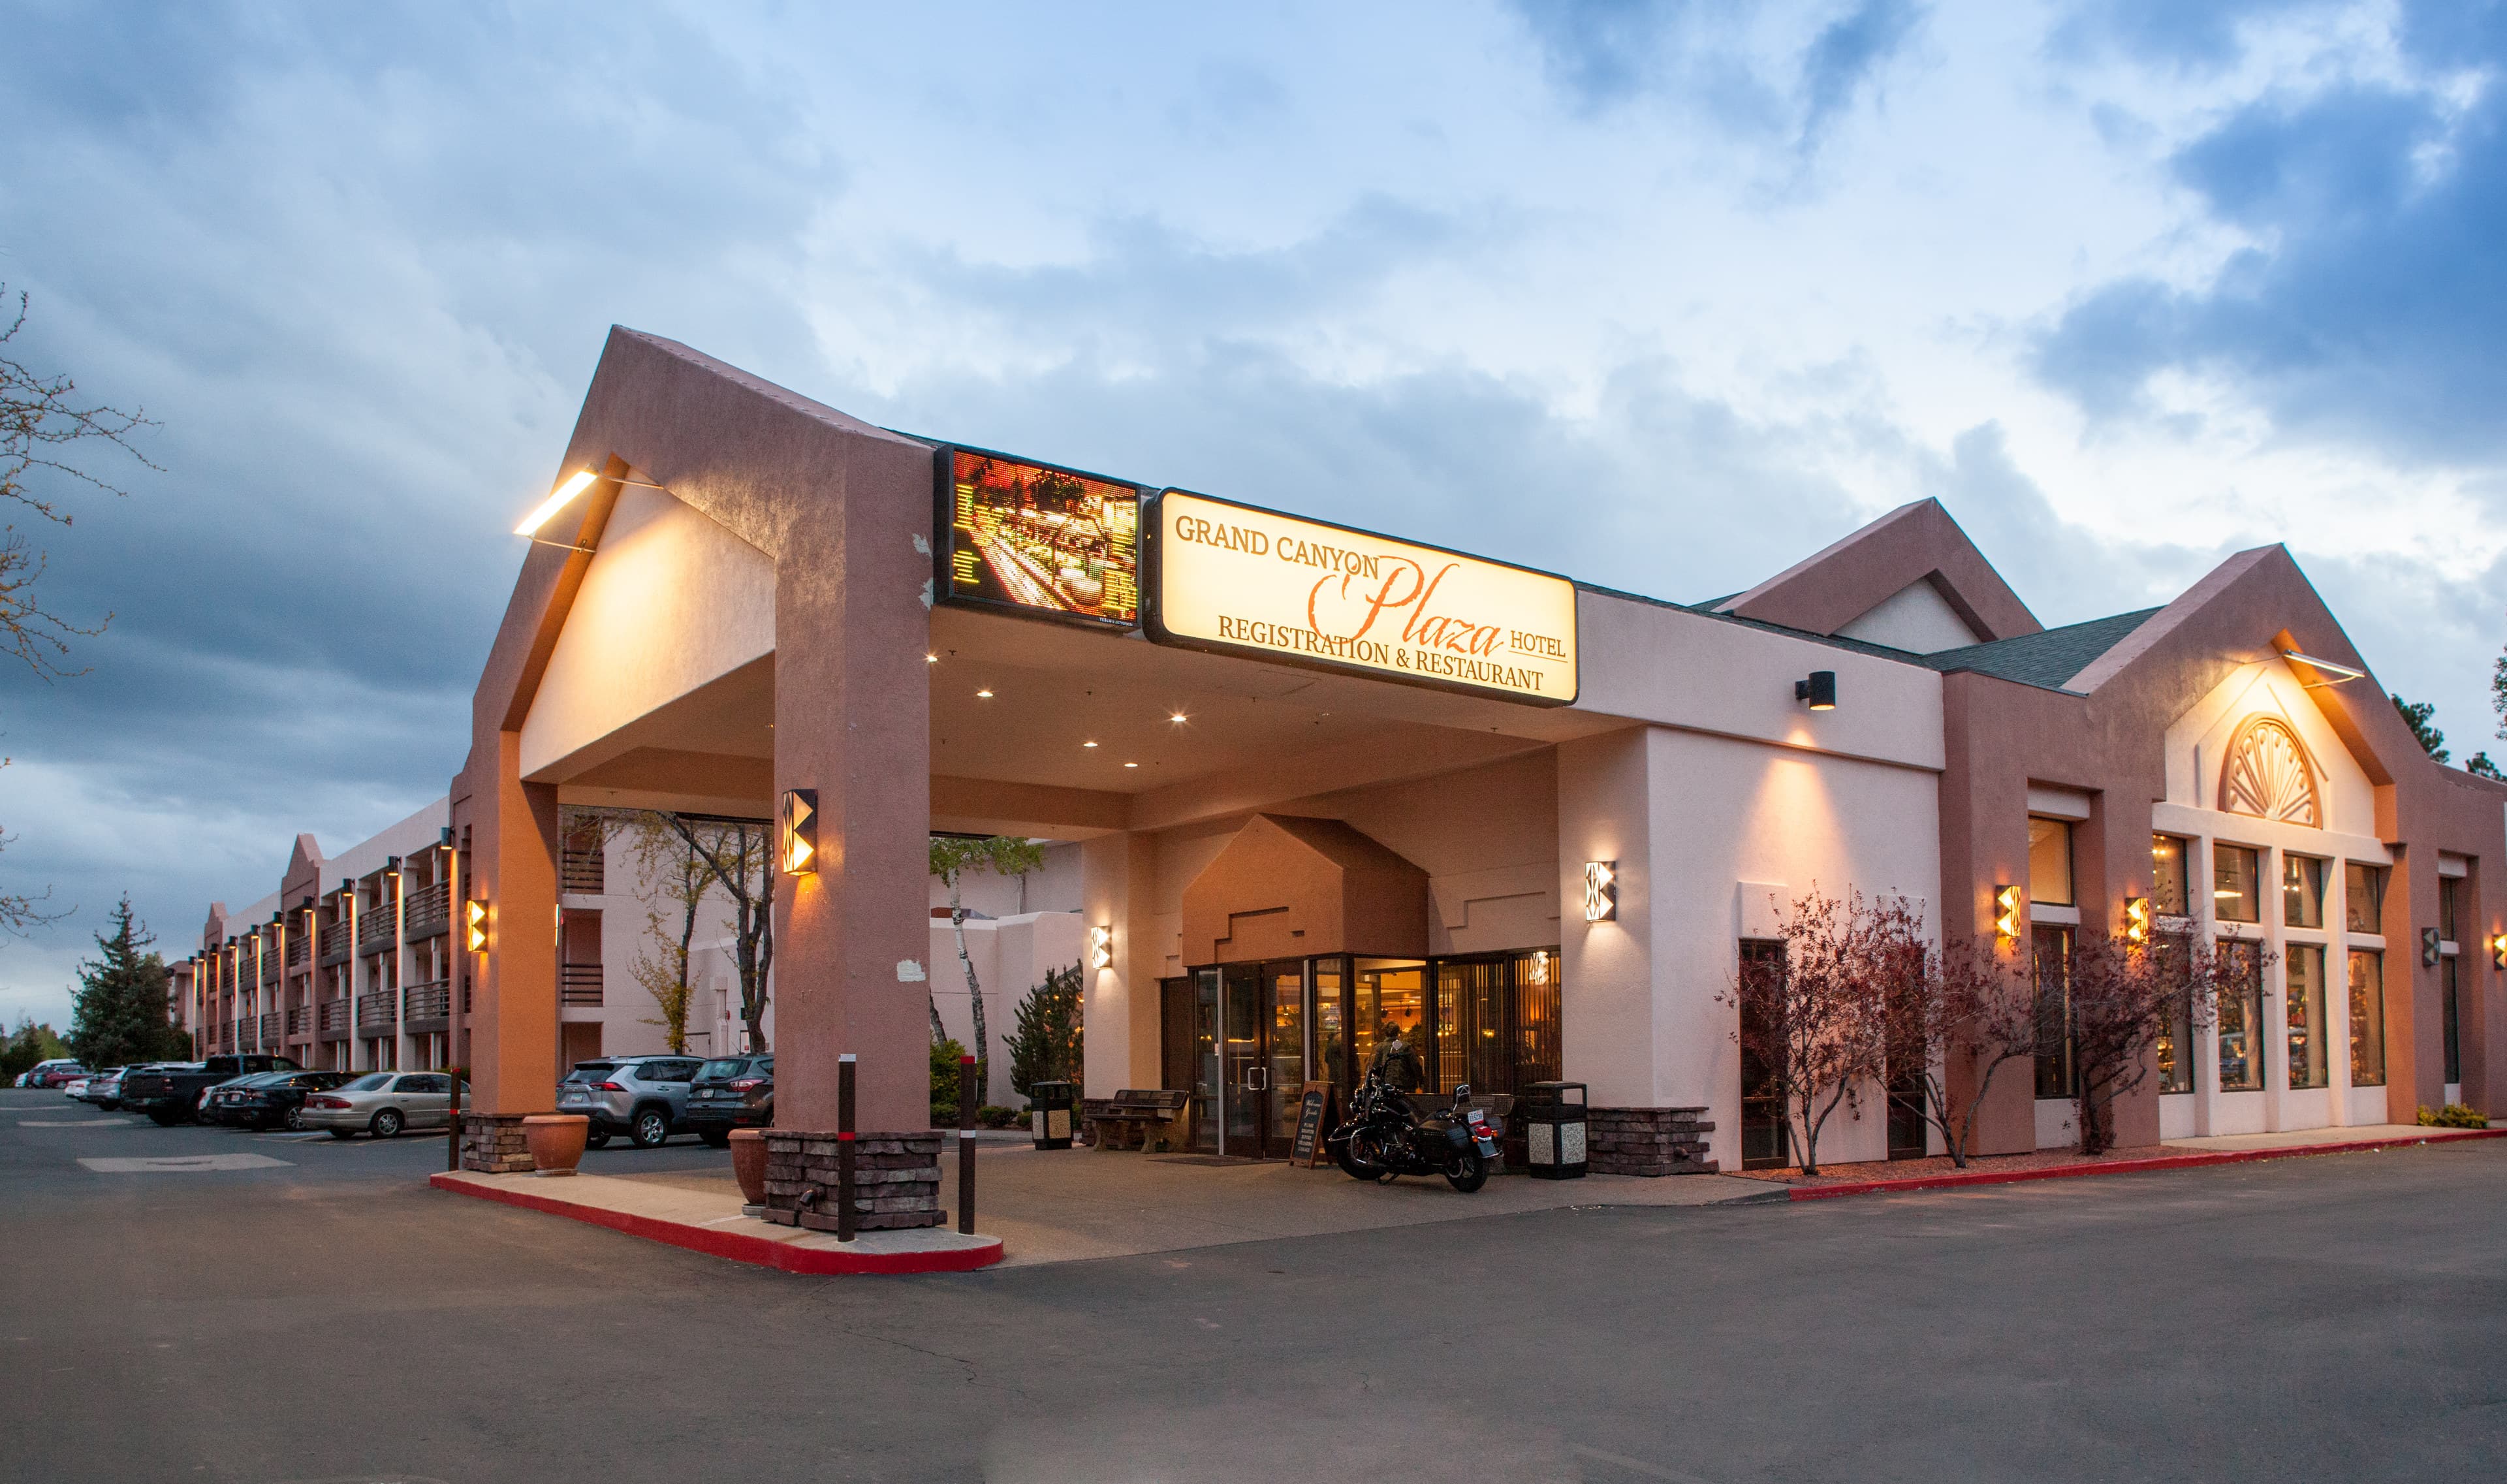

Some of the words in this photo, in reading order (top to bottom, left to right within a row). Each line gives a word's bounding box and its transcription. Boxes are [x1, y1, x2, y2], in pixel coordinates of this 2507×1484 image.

[1176, 516, 1269, 555] GRAND
[1277, 537, 1379, 579] CANYON
[1308, 556, 1504, 657] Plaza
[1511, 630, 1566, 657] HOTEL
[1218, 616, 1389, 664] REGISTRATION
[1396, 648, 1410, 669] &
[1415, 650, 1543, 690] RESTAURANT
